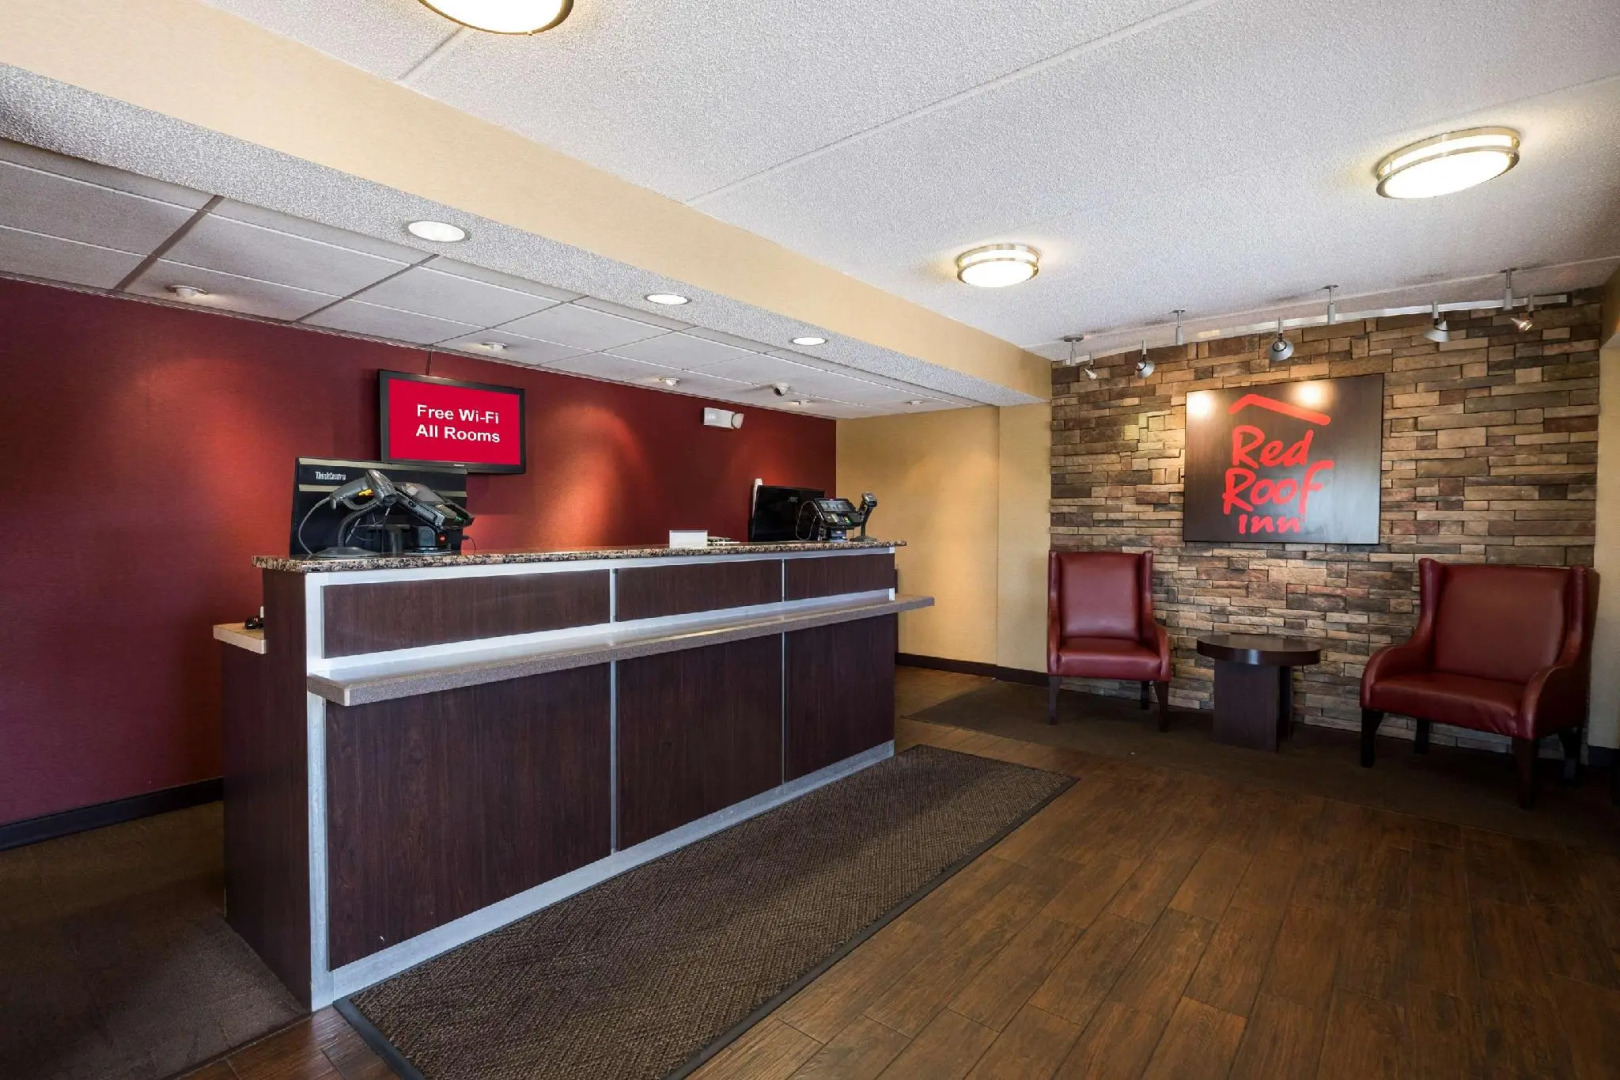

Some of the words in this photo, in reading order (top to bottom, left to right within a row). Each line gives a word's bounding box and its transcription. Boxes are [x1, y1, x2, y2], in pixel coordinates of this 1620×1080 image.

[417, 404, 454, 420] Free
[458, 408, 499, 424] Wi-Fi
[415, 424, 439, 438] All
[443, 426, 500, 443] Rooms
[1232, 425, 1314, 469] Red
[1222, 460, 1335, 515] Roof
